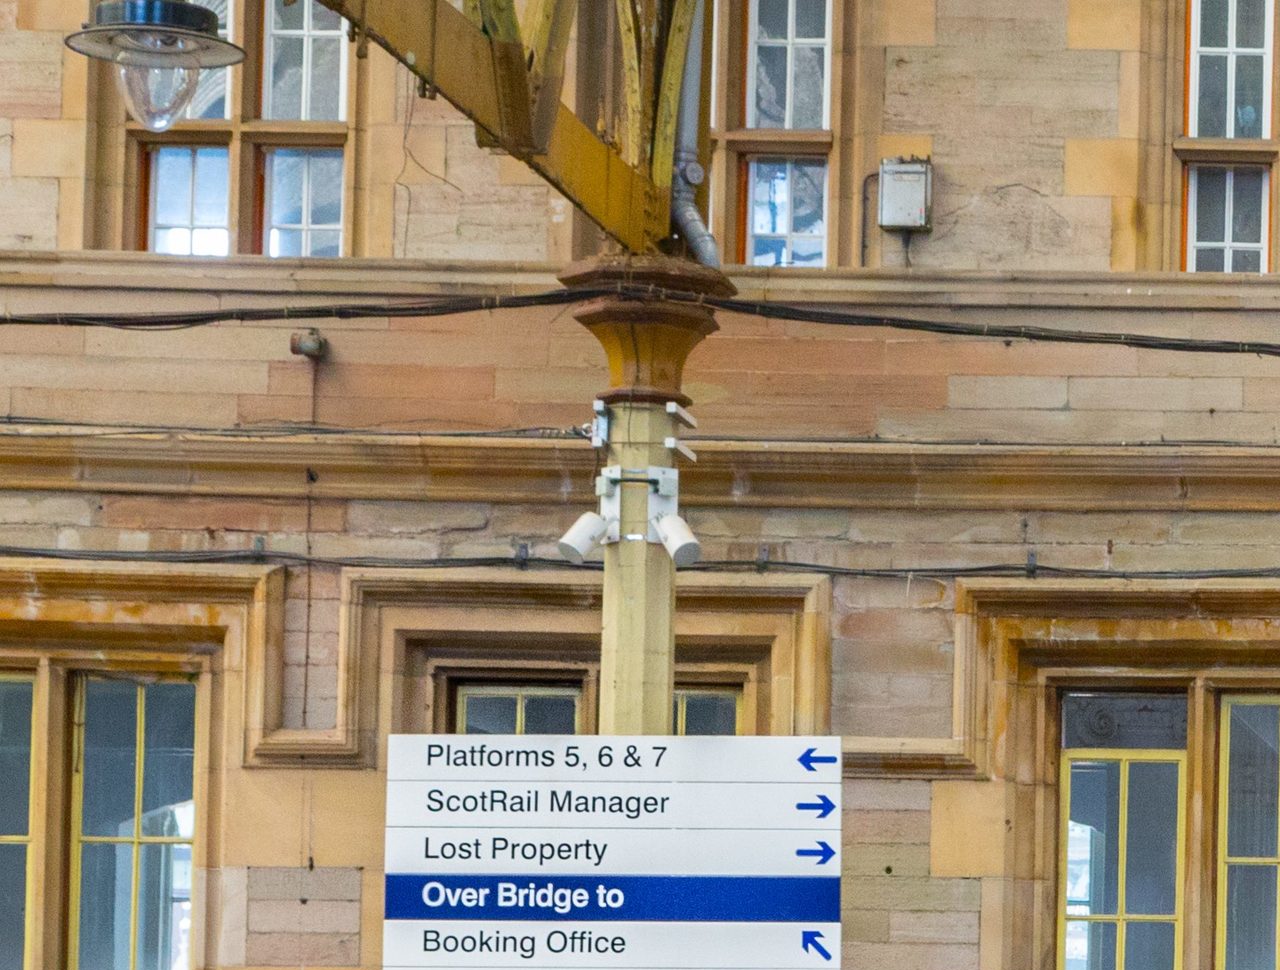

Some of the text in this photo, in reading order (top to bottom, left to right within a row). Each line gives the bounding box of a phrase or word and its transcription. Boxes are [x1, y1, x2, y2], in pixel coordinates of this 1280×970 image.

[427, 744, 667, 771] Platforms 5, 6 & 7
[427, 789, 670, 820] ScotRail Manager
[424, 837, 608, 867] Lost Property
[421, 881, 625, 914] Over Bridge to
[423, 929, 626, 959] Booking Office
